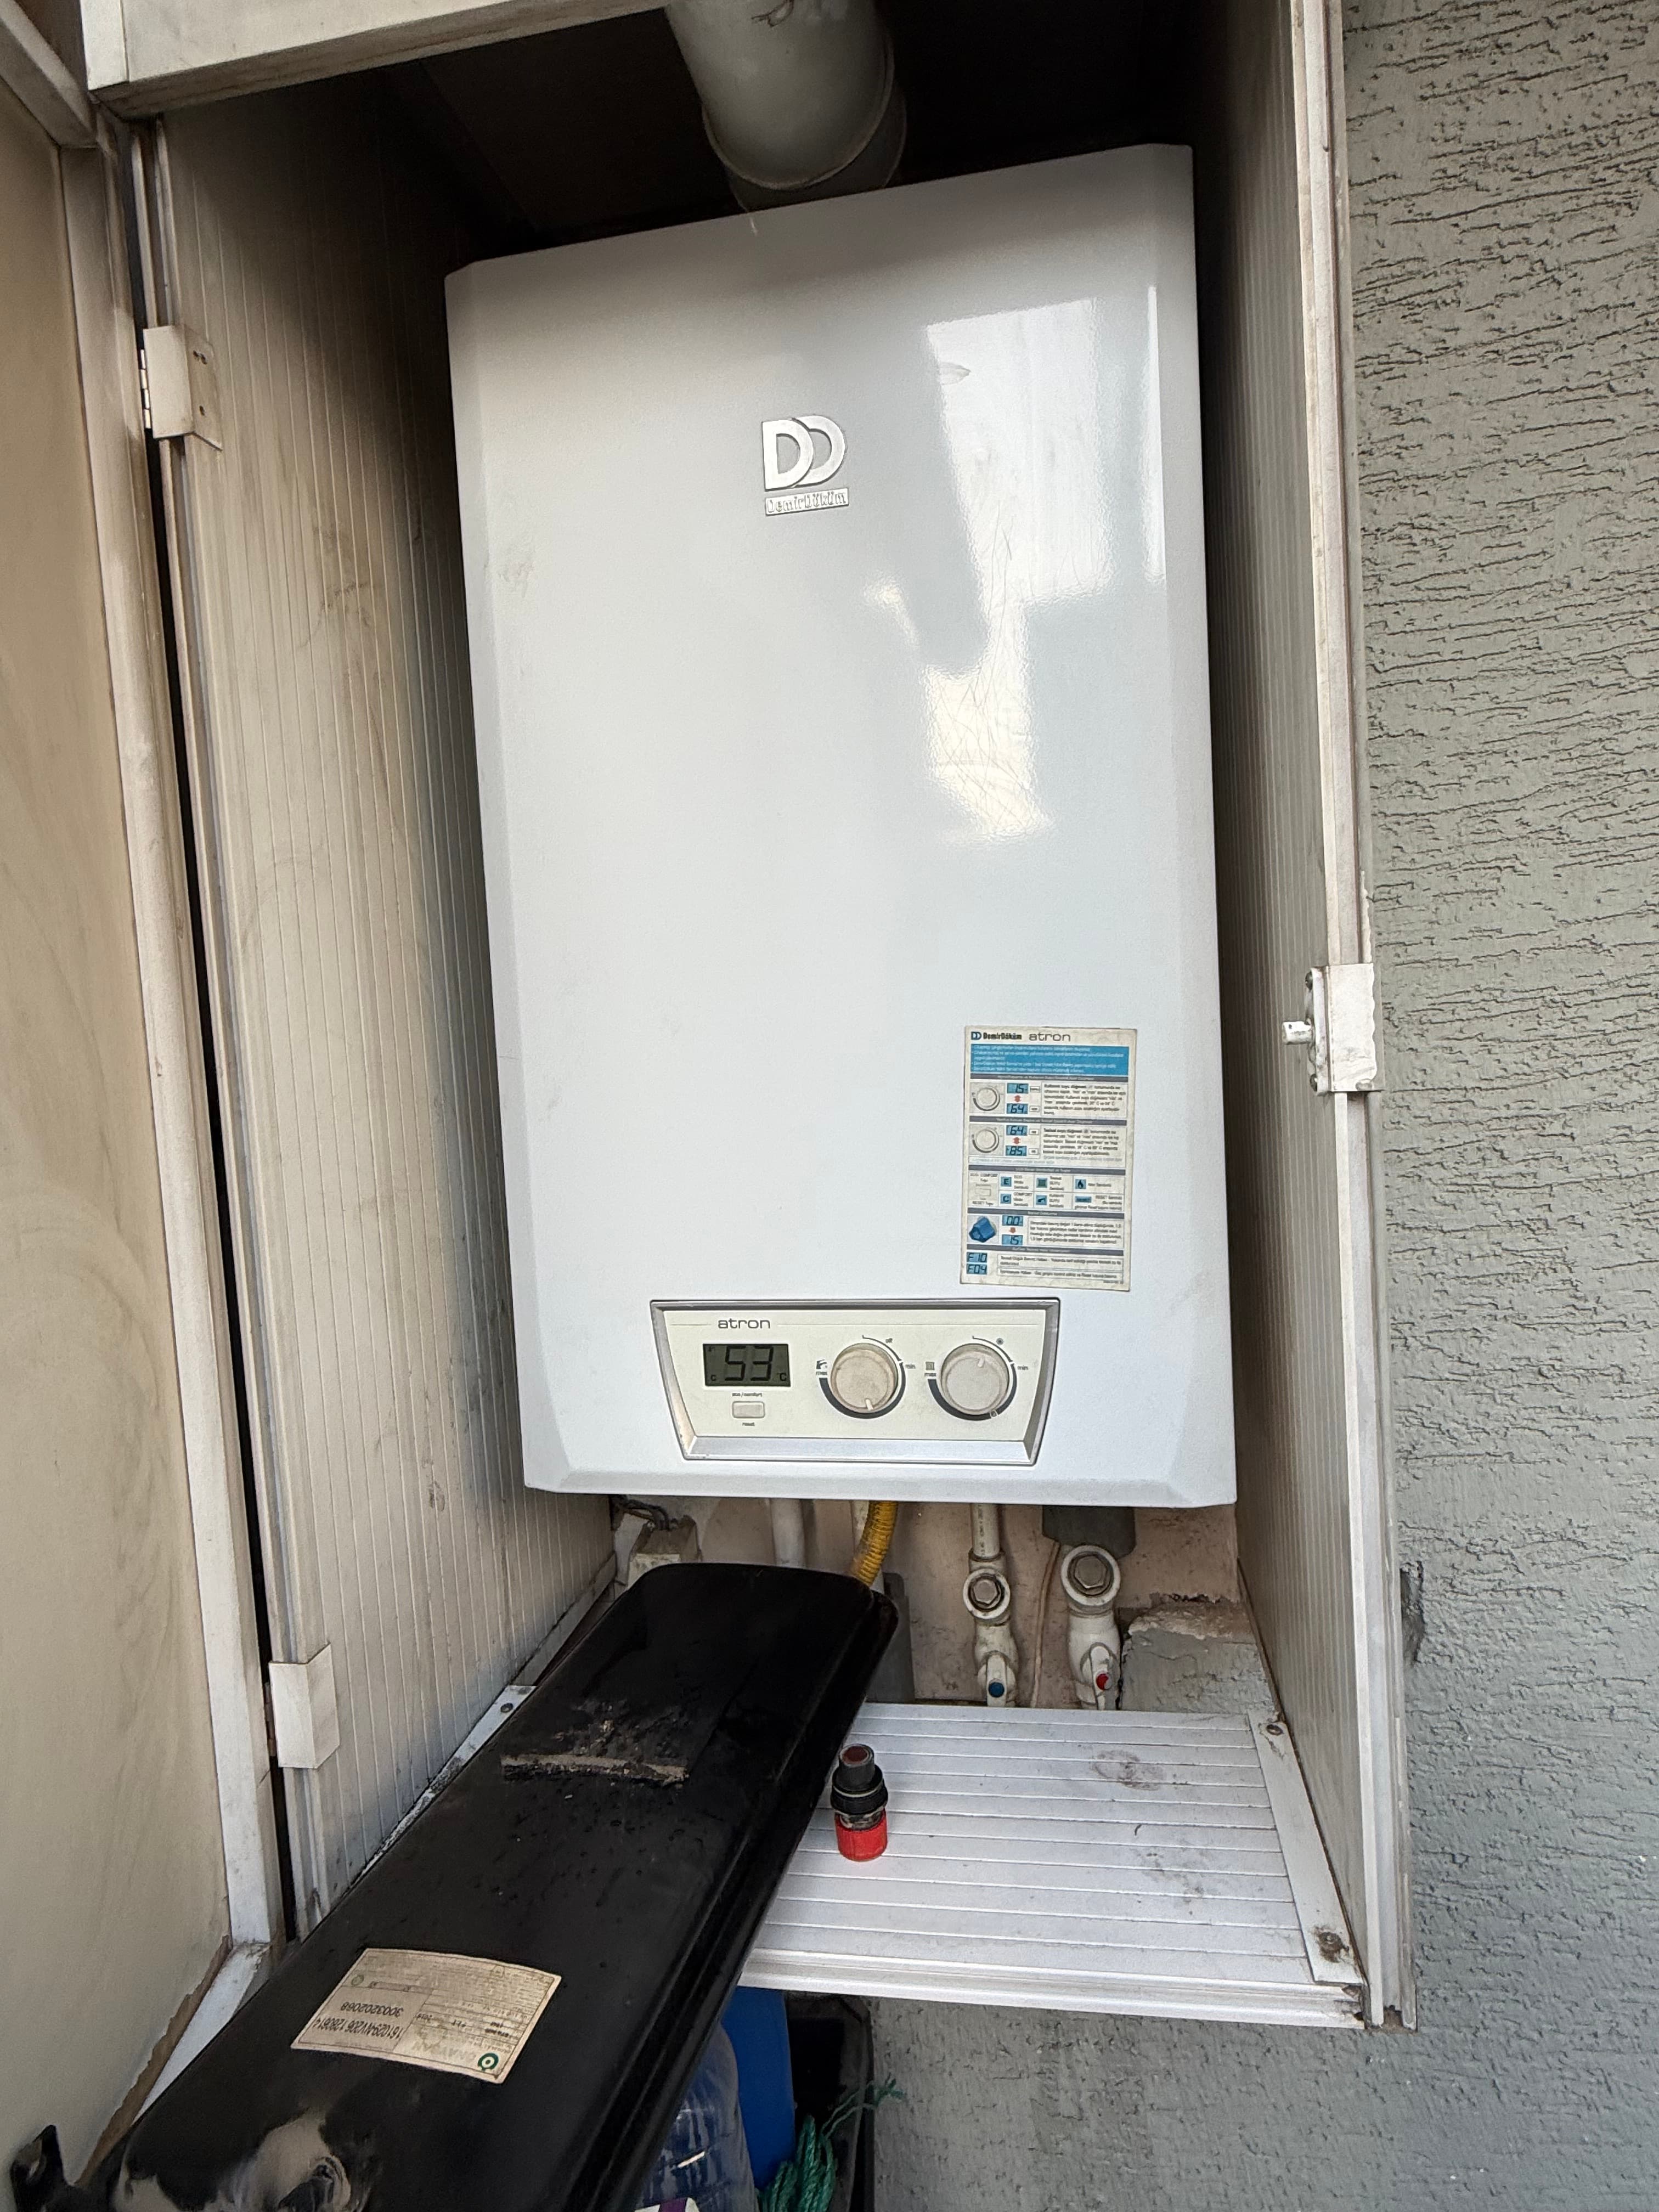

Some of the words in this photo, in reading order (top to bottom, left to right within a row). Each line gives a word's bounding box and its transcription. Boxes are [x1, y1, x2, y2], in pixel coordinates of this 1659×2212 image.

[1029, 1032, 1071, 1042] atron
[718, 1318, 770, 1329] atron
[724, 1345, 774, 1381] 53
